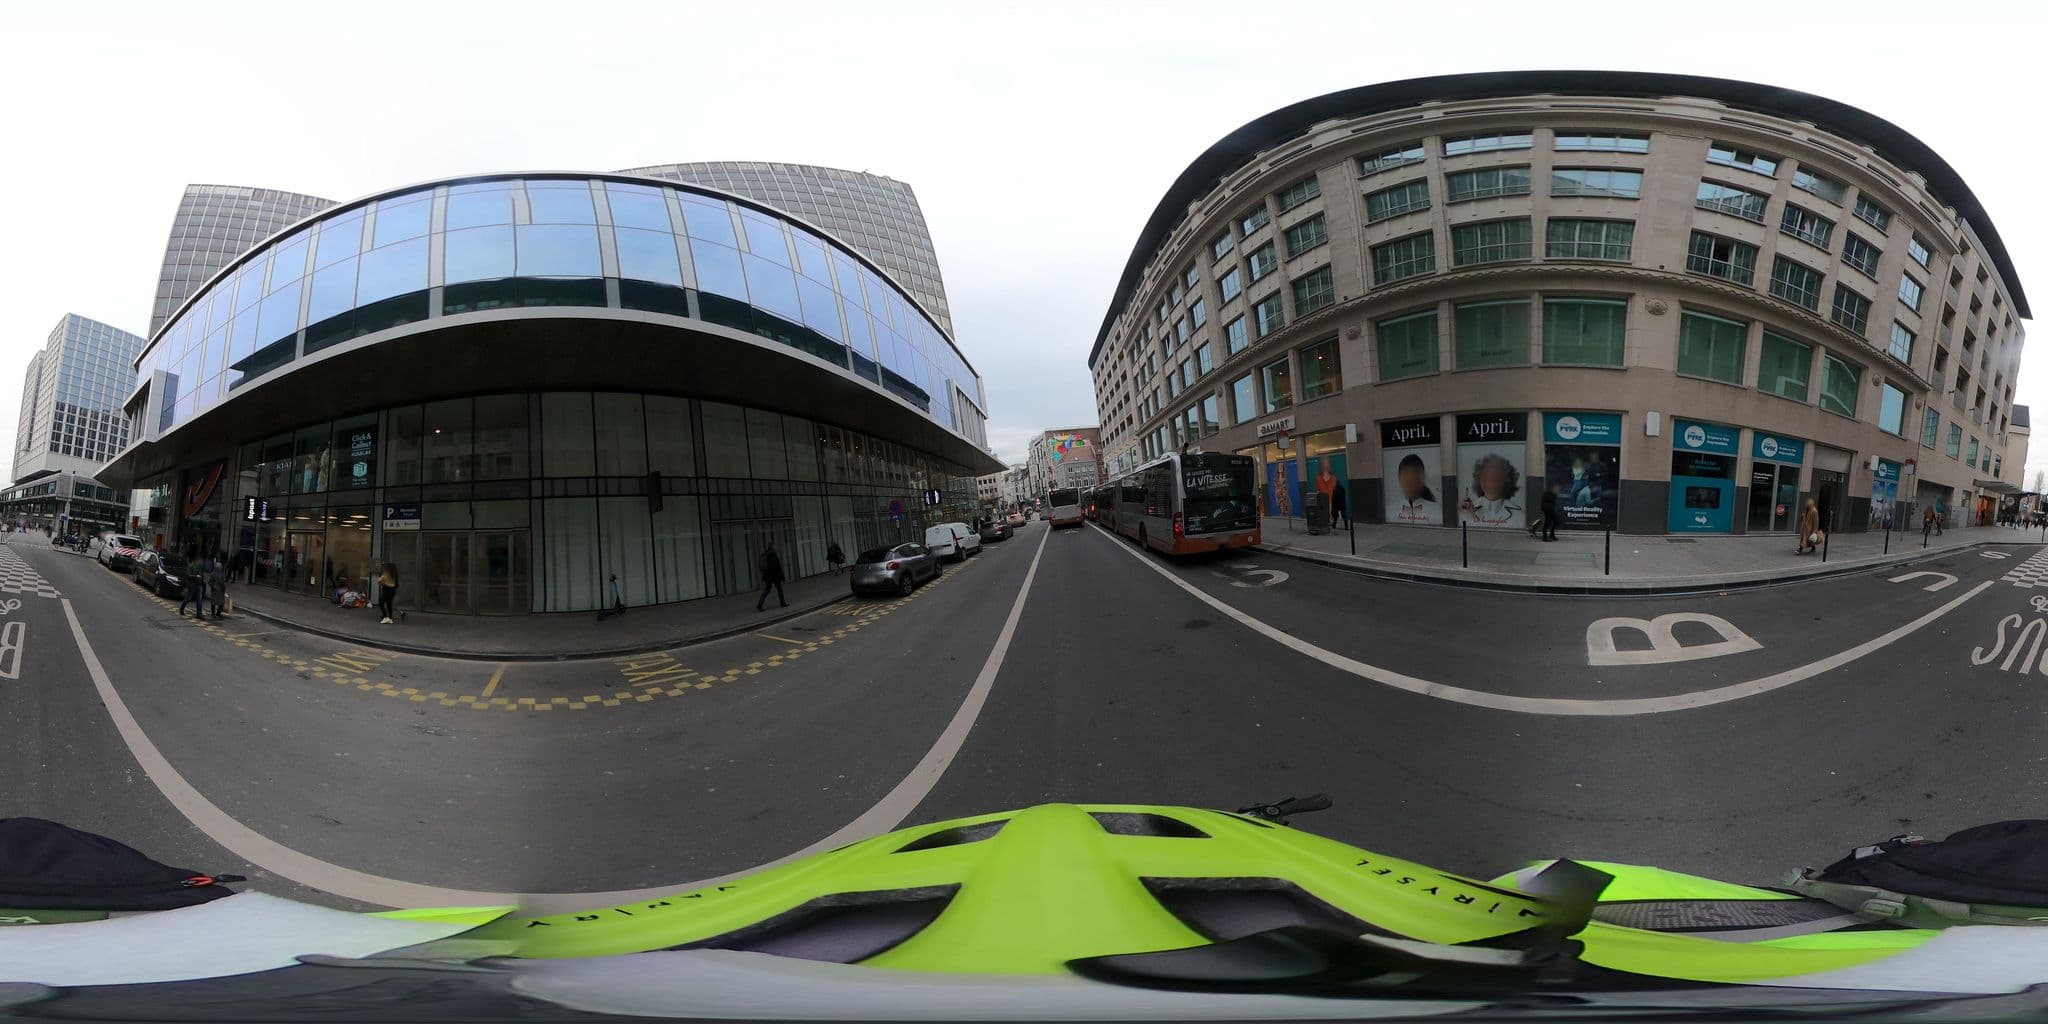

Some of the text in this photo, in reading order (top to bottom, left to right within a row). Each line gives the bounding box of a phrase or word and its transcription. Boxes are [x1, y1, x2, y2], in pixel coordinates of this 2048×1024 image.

[1261, 419, 1289, 433] DAMART
[1186, 477, 1197, 488] LA
[1197, 473, 1228, 487] VITESSE
[247, 498, 256, 519] bpost
[386, 507, 395, 519] P
